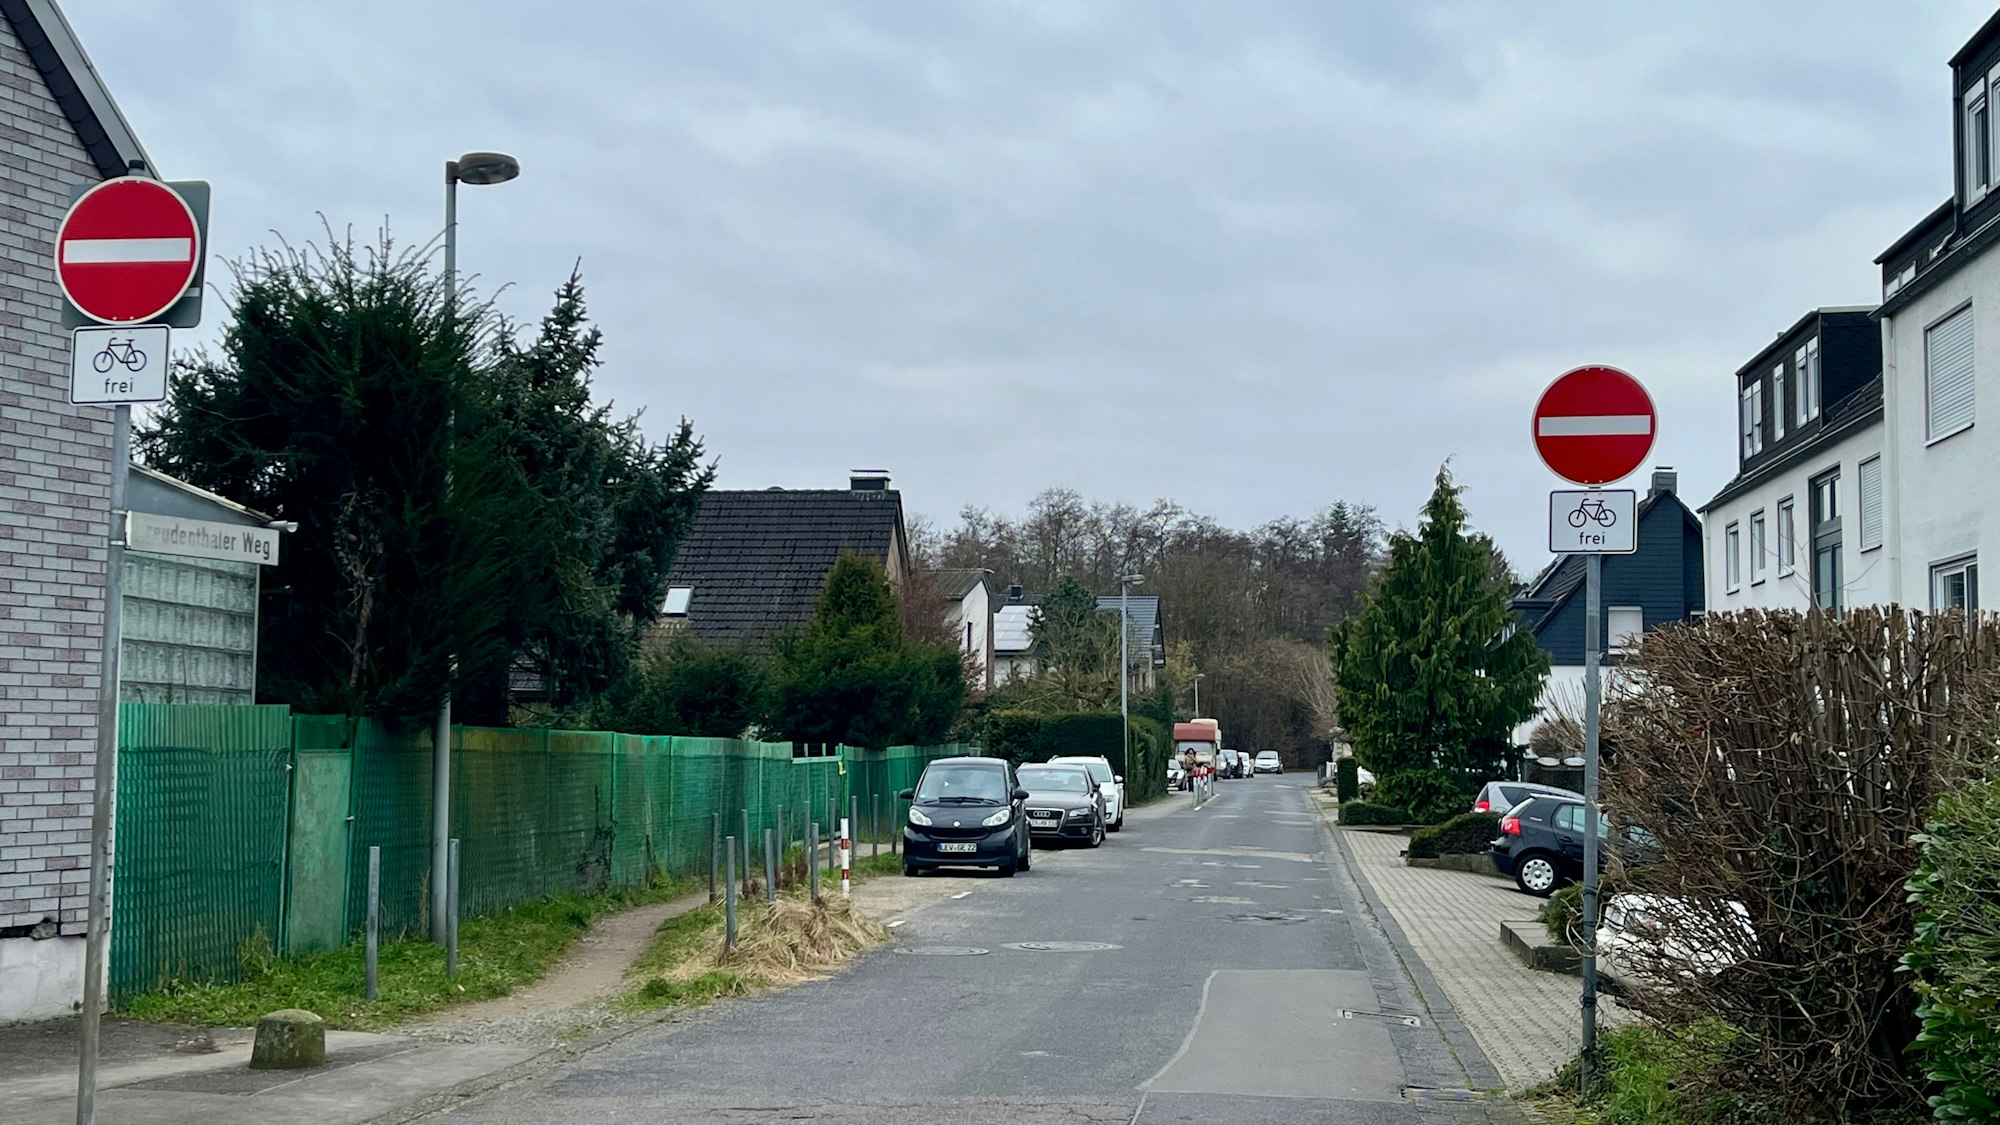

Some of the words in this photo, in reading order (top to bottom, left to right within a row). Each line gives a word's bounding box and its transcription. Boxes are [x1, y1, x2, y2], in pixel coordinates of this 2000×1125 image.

[104, 376, 134, 394] frei
[144, 522, 237, 552] reudenthaler
[241, 530, 271, 560] Weg
[1579, 531, 1605, 545] frei
